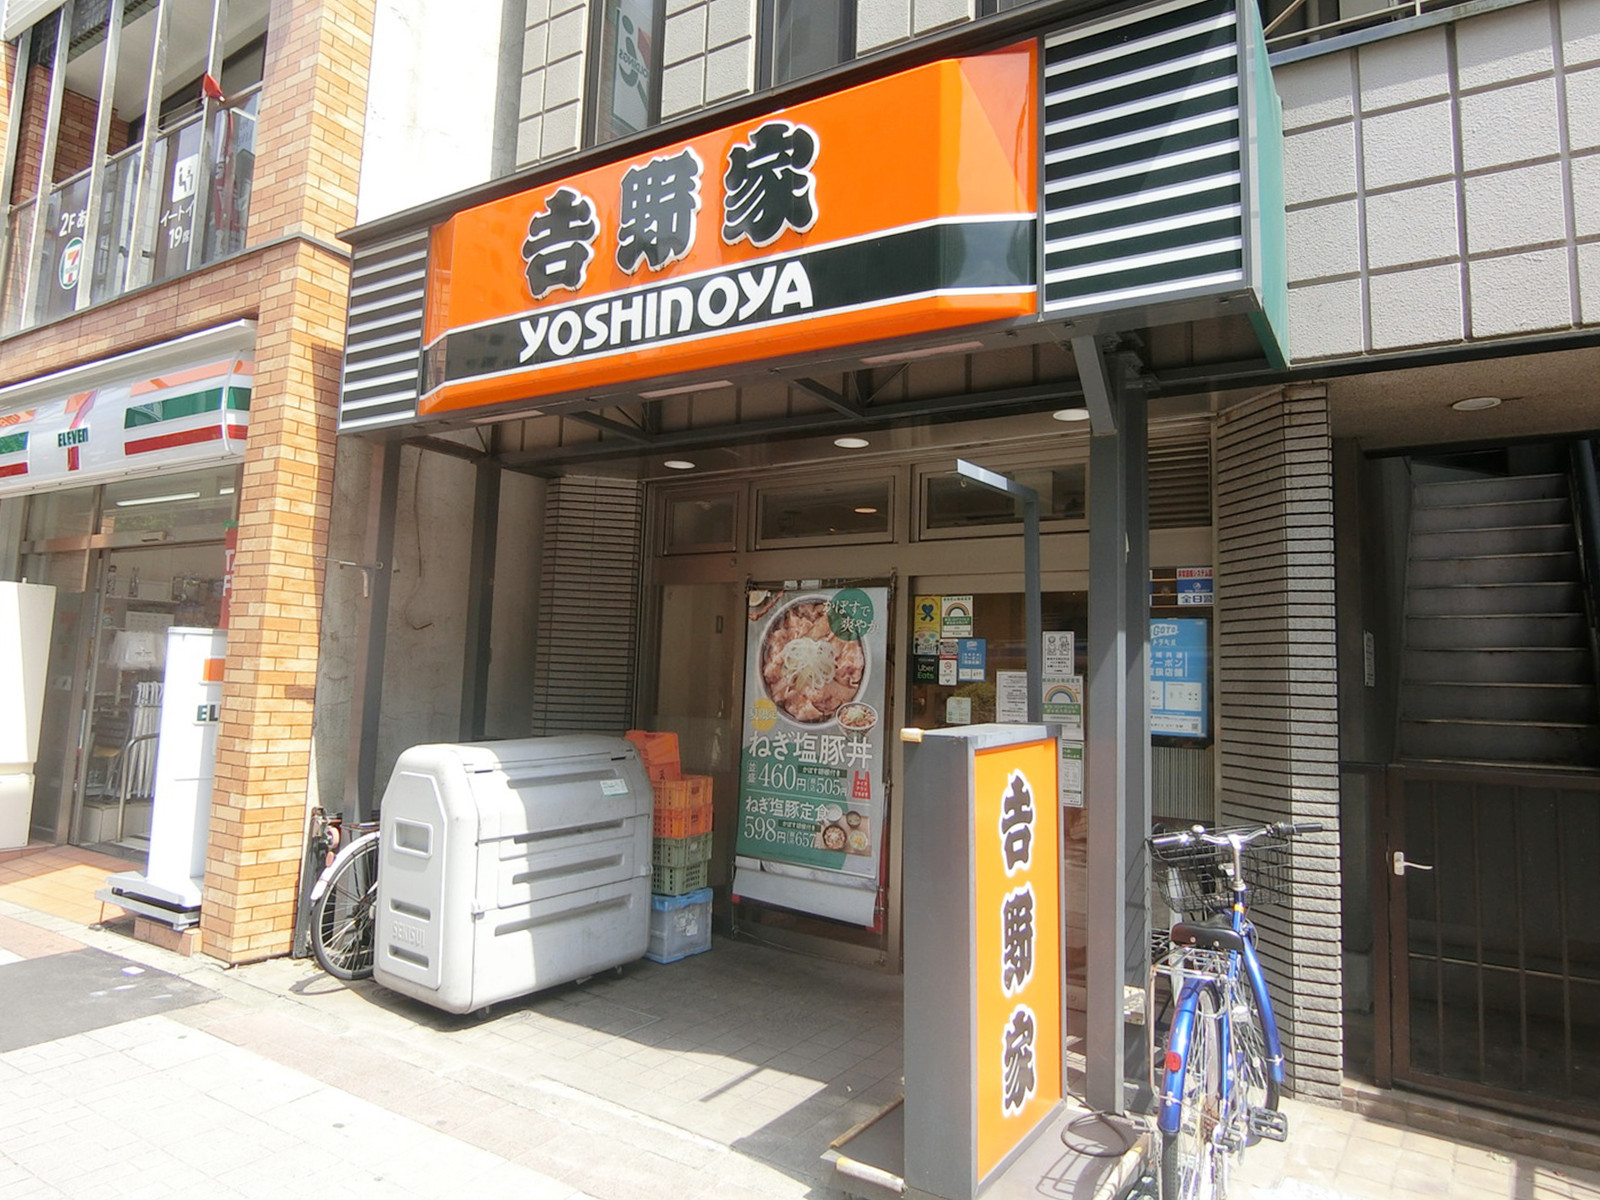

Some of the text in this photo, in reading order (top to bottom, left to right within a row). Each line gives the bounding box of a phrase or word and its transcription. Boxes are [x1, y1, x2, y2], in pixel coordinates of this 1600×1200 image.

[522, 121, 820, 300] 吉野家
[519, 260, 814, 364] YOSHINOYA
[748, 731, 873, 769] ねぎ塩豚丼
[745, 796, 830, 823] ねぎ塩豚定食
[1000, 769, 1037, 1117] 吉野家
